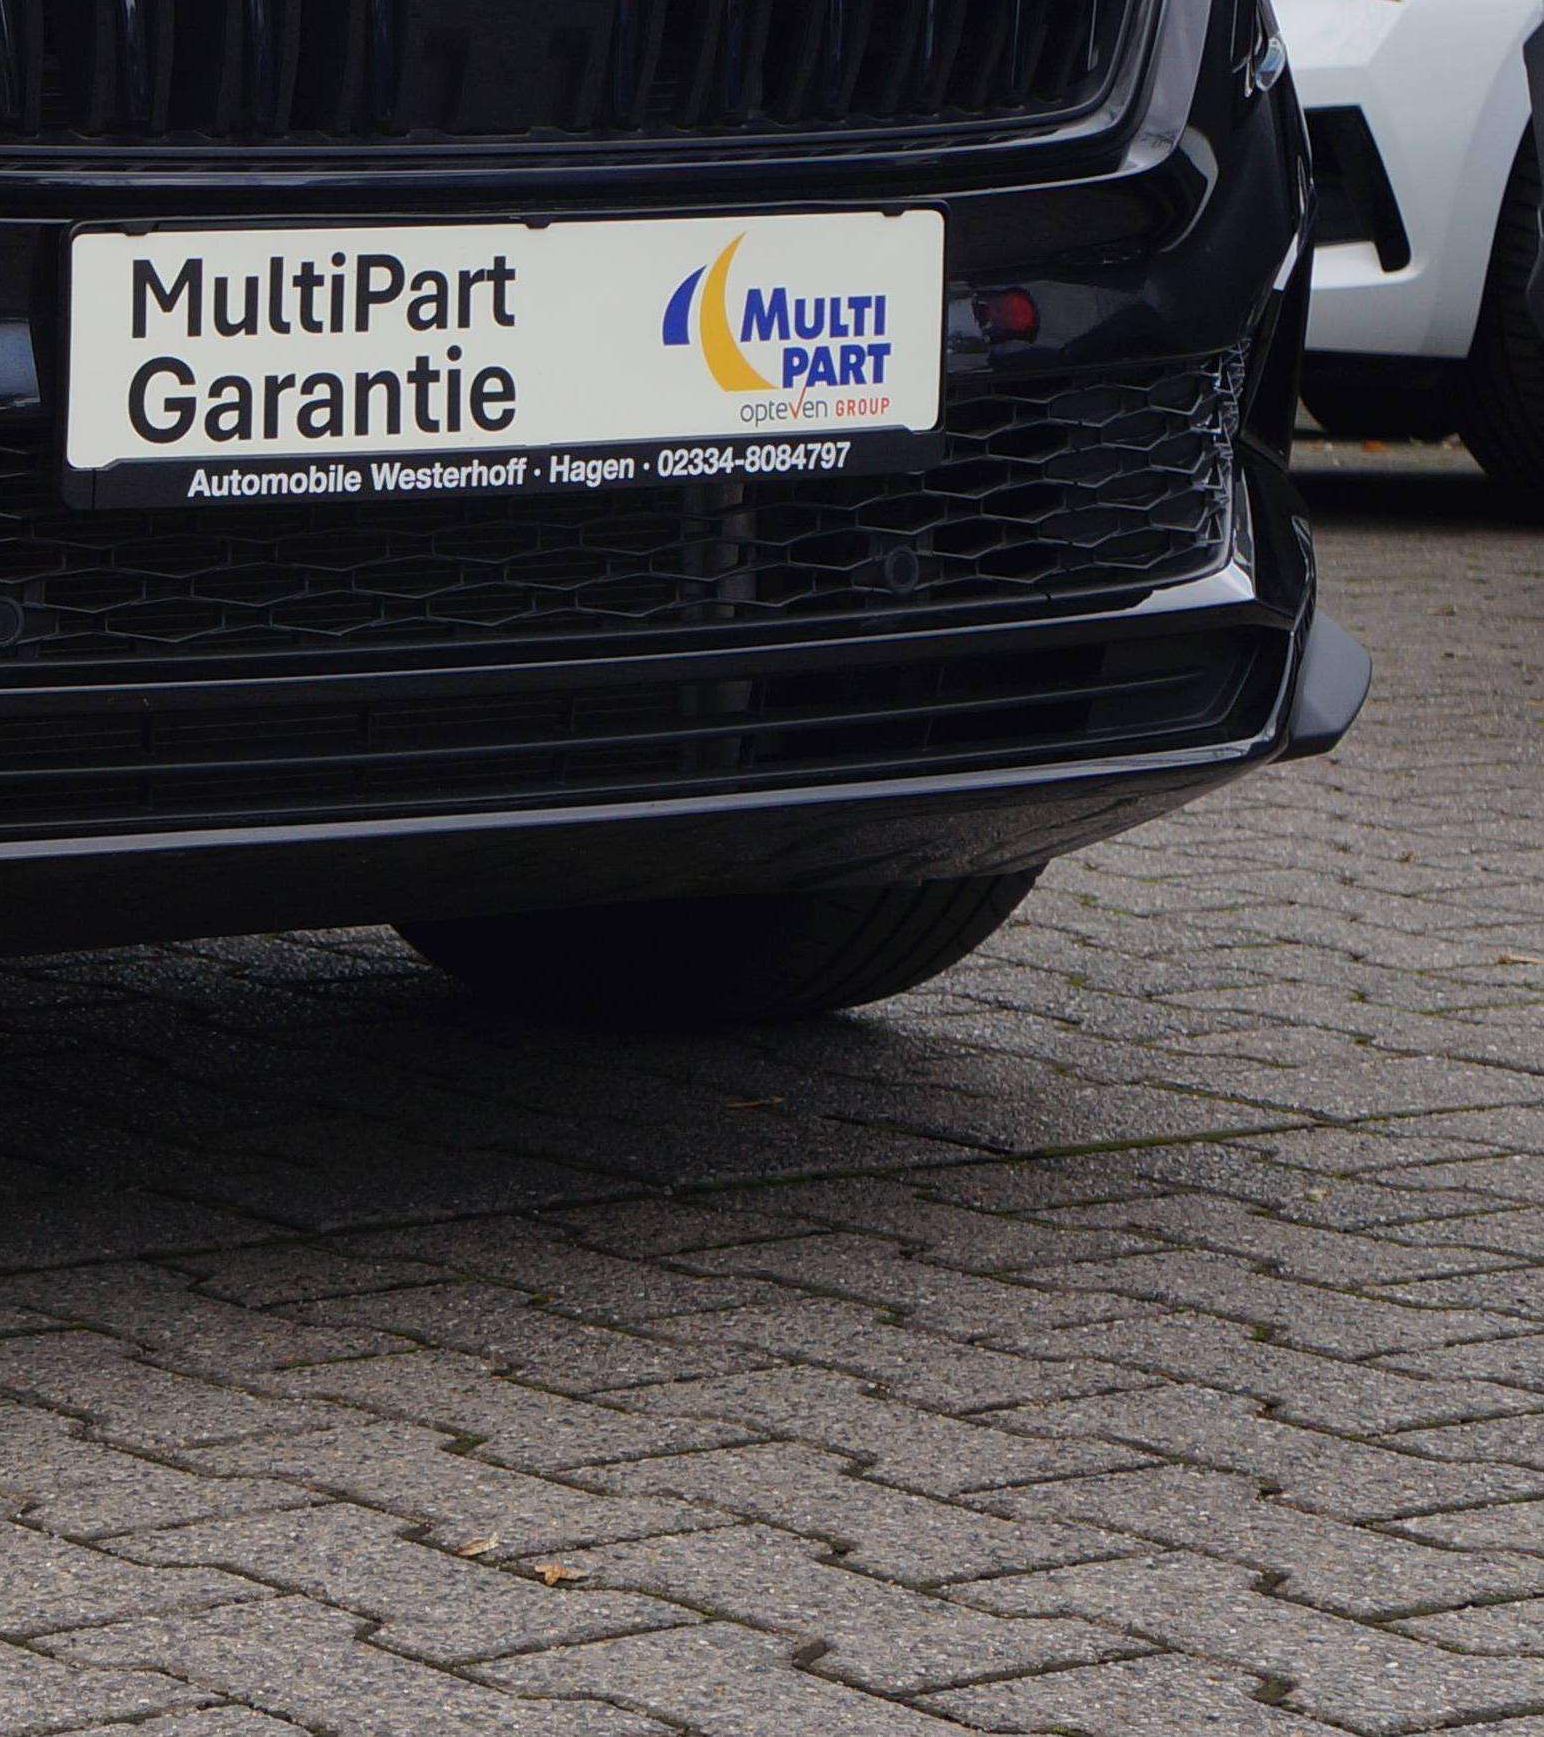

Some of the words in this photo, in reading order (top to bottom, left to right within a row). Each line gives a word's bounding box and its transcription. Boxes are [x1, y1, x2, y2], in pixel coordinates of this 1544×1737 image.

[132, 252, 516, 339] MultiPart
[740, 287, 886, 342] MULTI
[782, 343, 891, 389] PART
[128, 345, 516, 444] Garantie
[740, 387, 828, 427] opteven
[835, 397, 890, 417] GROUP
[187, 465, 361, 497] Automobile
[371, 457, 527, 491] Westerhoff
[549, 454, 634, 487] Hagen
[658, 442, 851, 477] 02334-8084797
